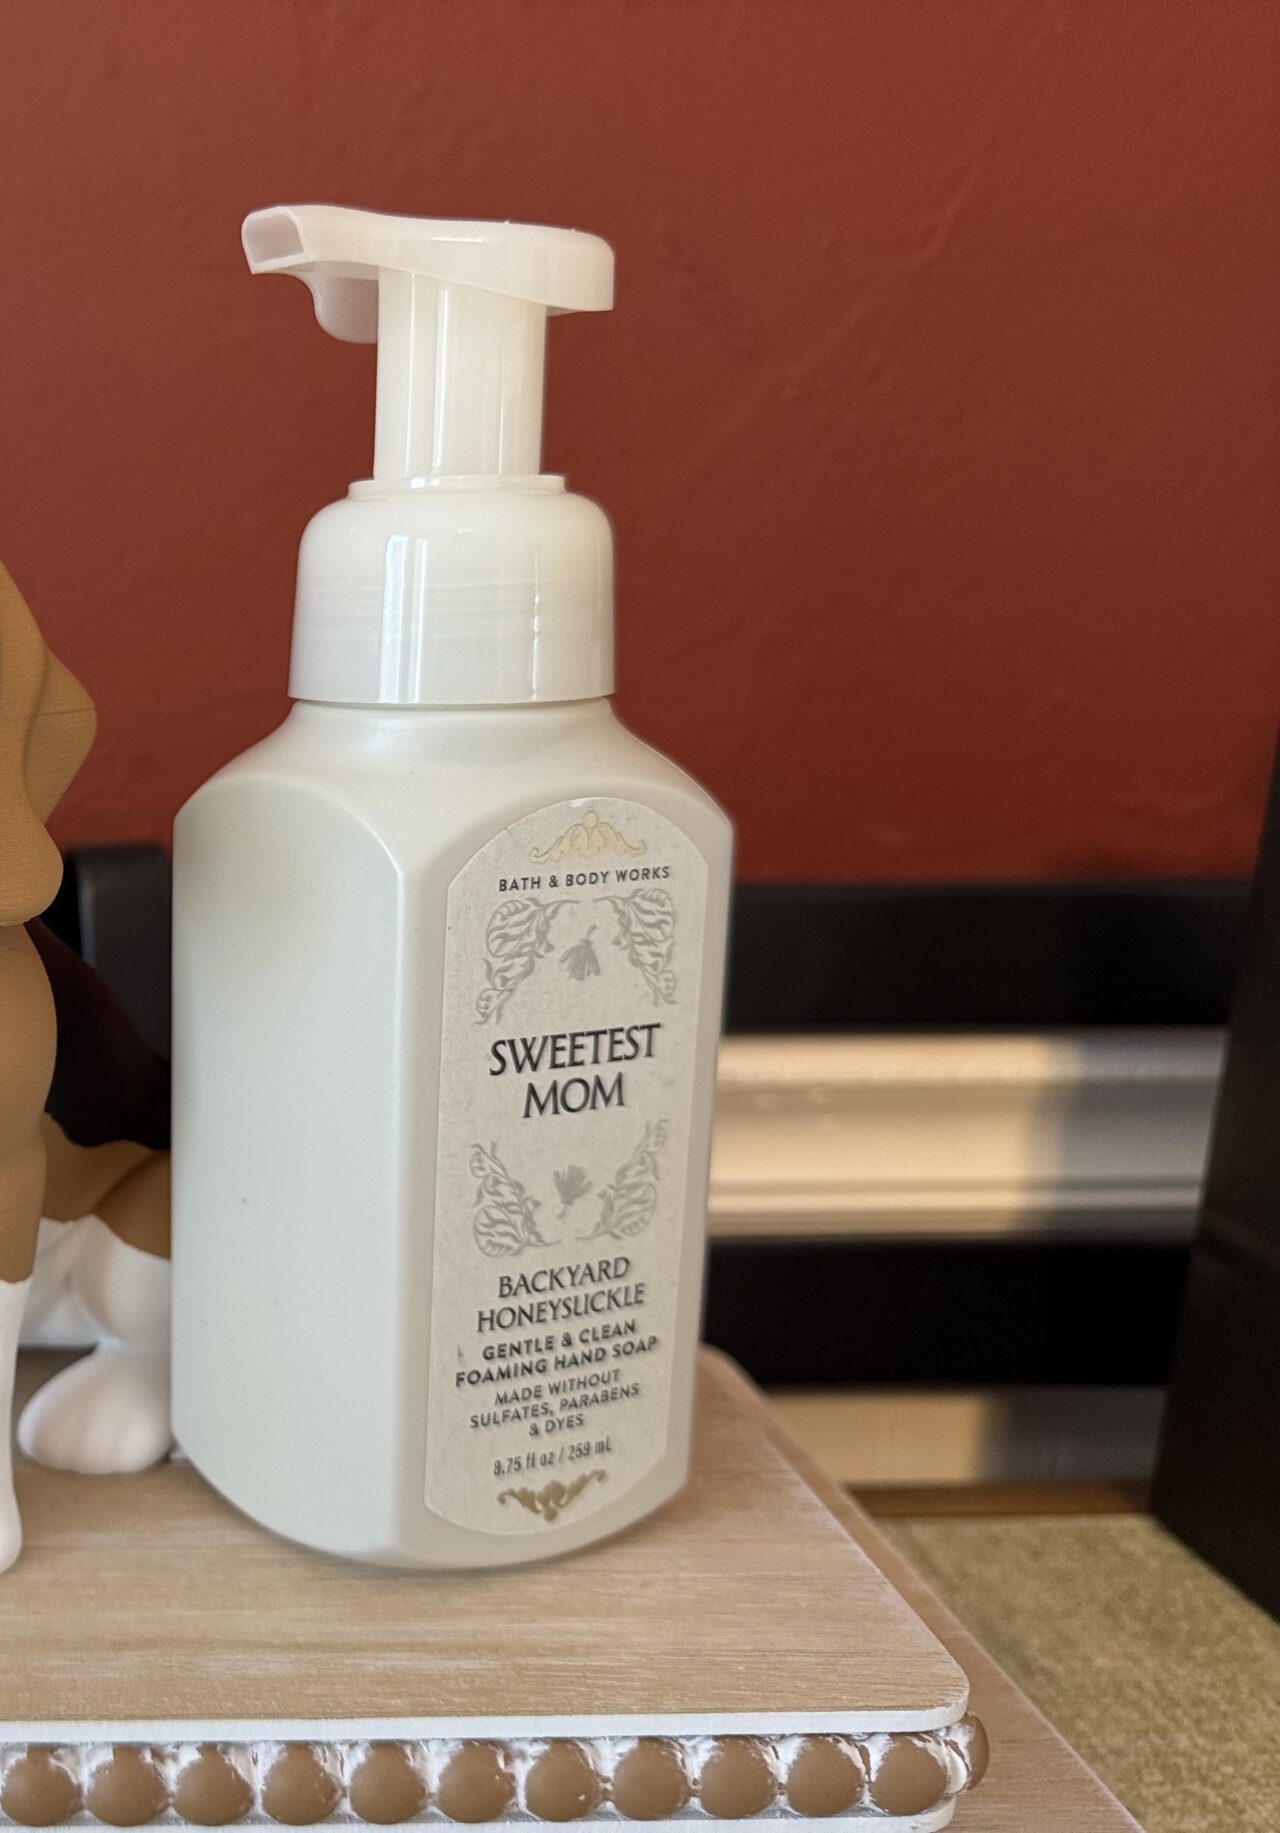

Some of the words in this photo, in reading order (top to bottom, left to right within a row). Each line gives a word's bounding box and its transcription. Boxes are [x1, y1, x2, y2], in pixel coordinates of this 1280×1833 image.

[498, 876, 541, 892] BATH
[548, 875, 559, 888] &
[565, 871, 609, 887] BODY
[615, 866, 670, 883] WORKS
[489, 1022, 662, 1076] SWEETEST
[522, 1071, 625, 1119] MOM
[498, 1256, 630, 1298] BACKYARD
[476, 1283, 645, 1332] HONEYSUCKLE
[482, 1335, 554, 1361] GENTLE
[561, 1332, 573, 1347] &
[578, 1319, 636, 1343] CLEAN
[455, 1359, 547, 1387] FOAMING
[554, 1346, 606, 1371] HAND
[612, 1336, 657, 1359] SOAP
[470, 1402, 554, 1428] SULFATES,
[559, 1383, 640, 1411] PARABENS
[495, 1385, 543, 1405] MADE
[548, 1369, 621, 1396] WITHOUT
[529, 1423, 539, 1436] &
[545, 1414, 585, 1433] DYES
[493, 1454, 521, 1476] 8.75
[525, 1451, 536, 1469] fl
[540, 1450, 554, 1465] oz
[558, 1446, 565, 1464] /
